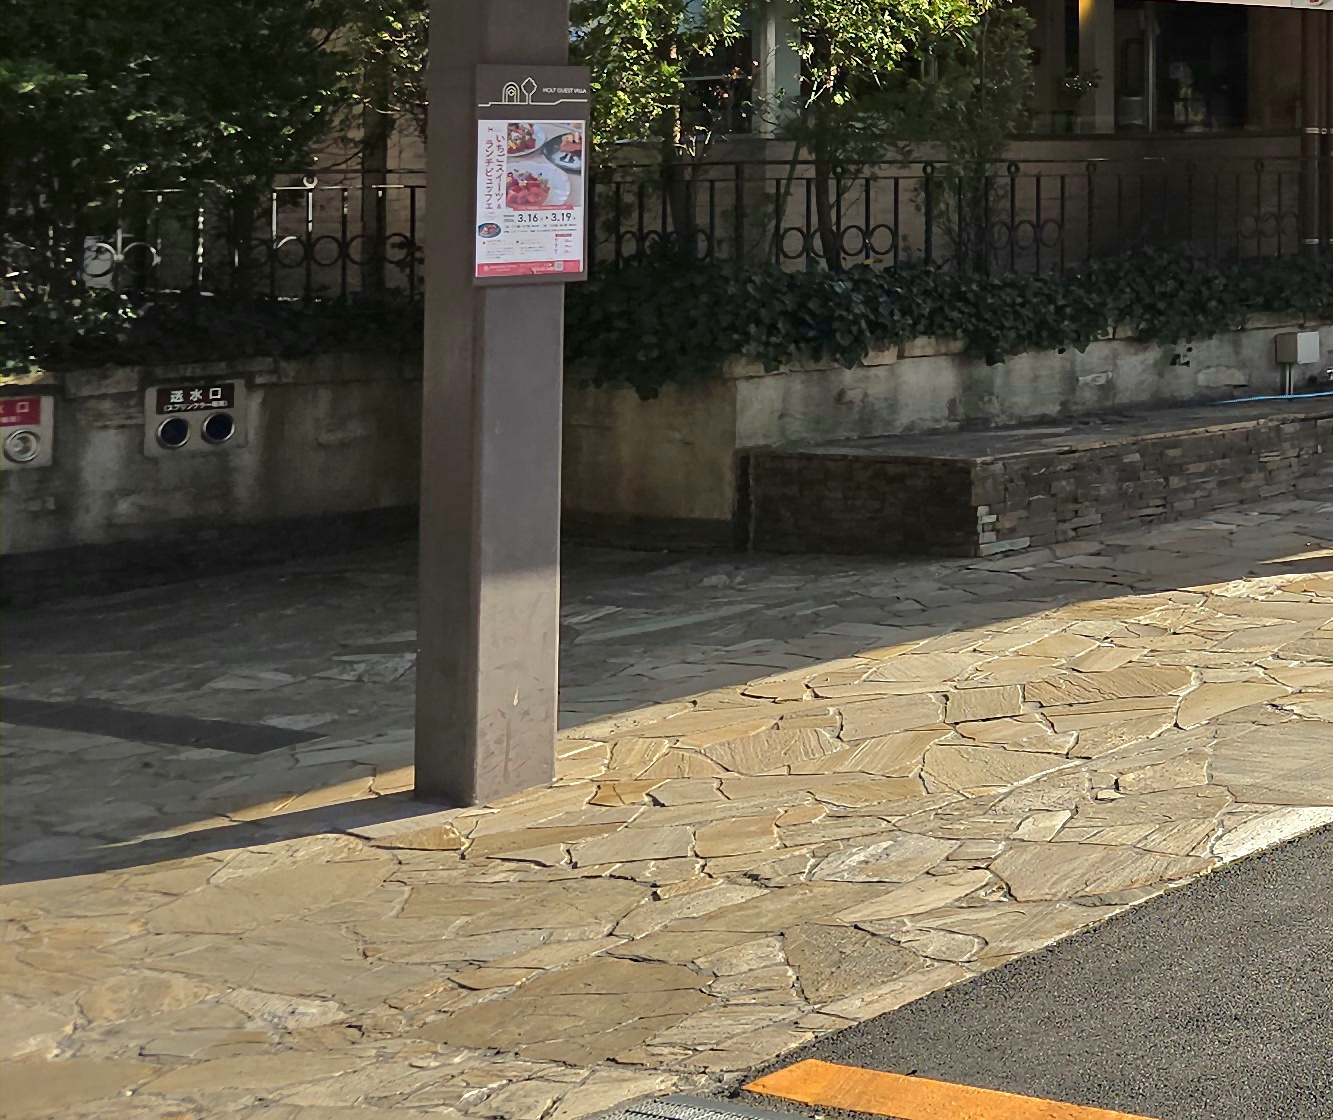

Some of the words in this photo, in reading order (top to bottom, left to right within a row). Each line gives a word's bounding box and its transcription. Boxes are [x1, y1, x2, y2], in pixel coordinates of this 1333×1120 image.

[517, 213, 539, 223] 3.16
[550, 212, 572, 222] 3.19
[169, 387, 222, 403] 送水口
